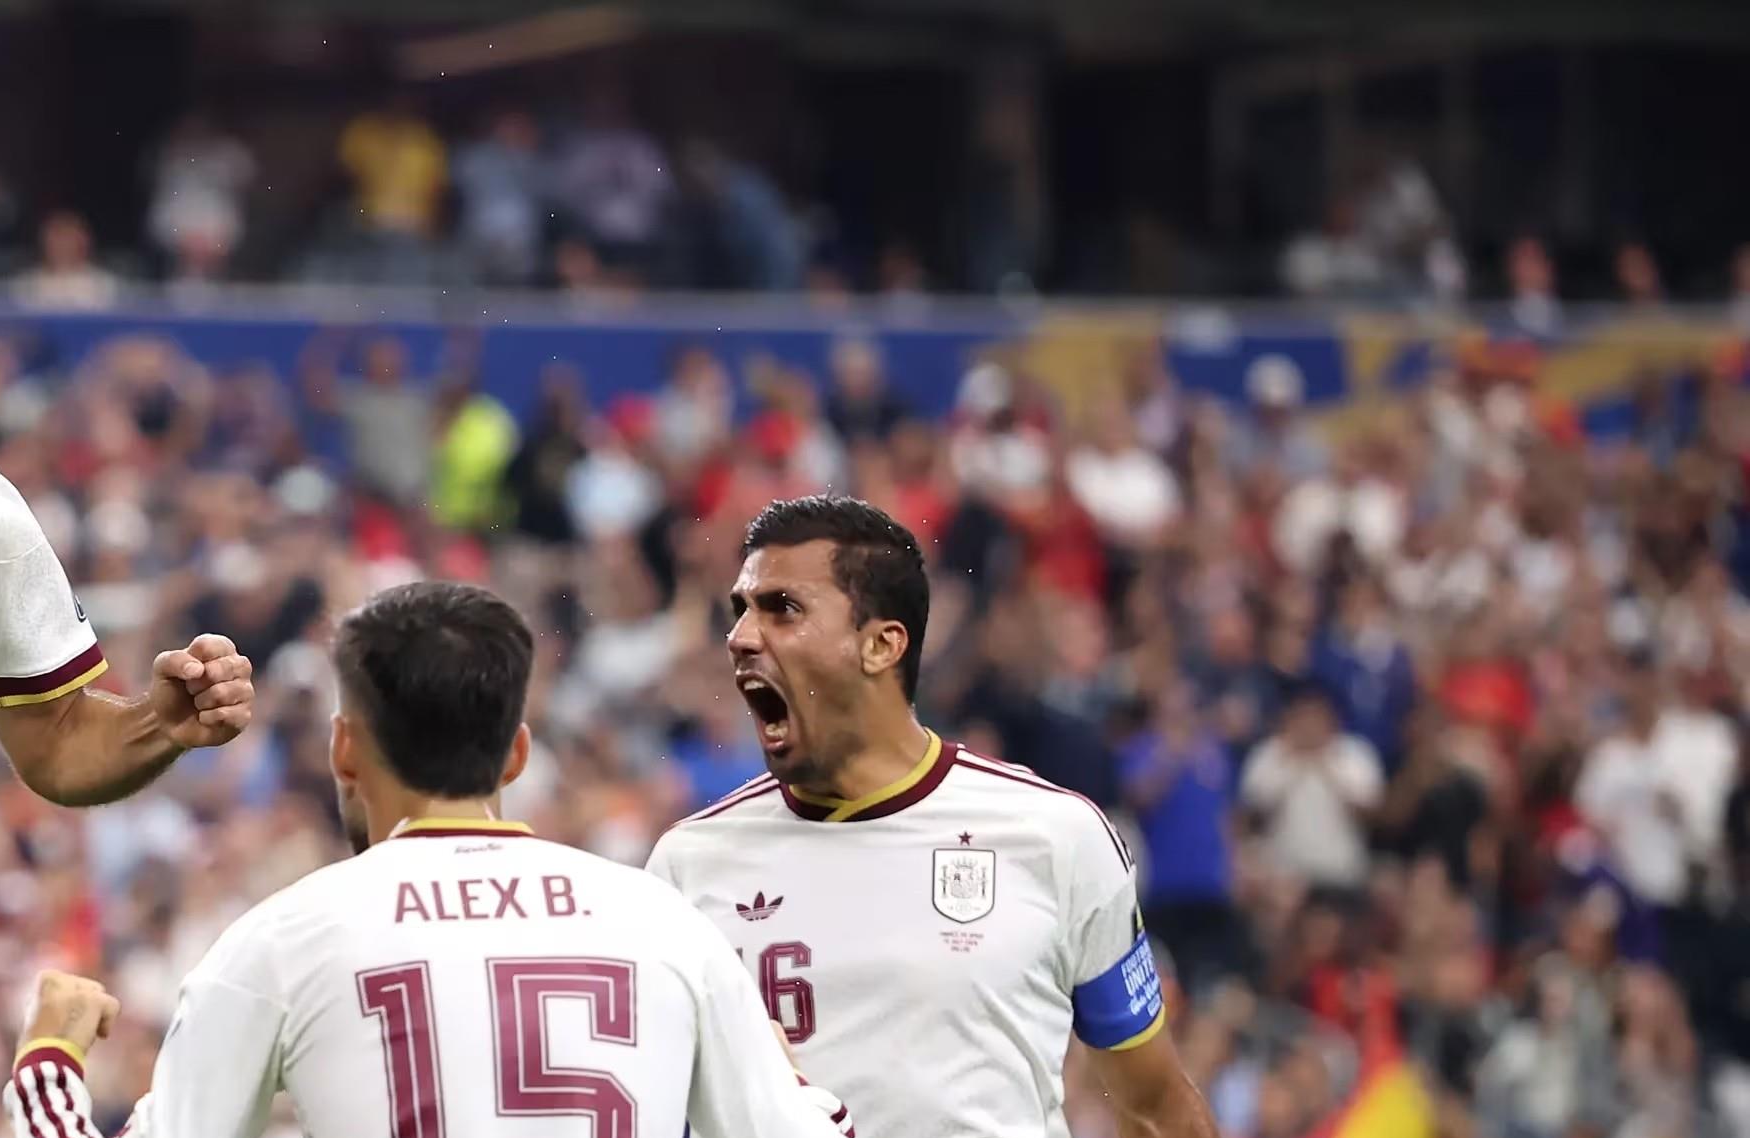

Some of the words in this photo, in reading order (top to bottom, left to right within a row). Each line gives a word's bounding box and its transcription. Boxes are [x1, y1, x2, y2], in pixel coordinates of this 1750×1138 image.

[395, 877, 528, 923] ALEX
[541, 875, 591, 918] B.
[736, 941, 816, 1044] 6
